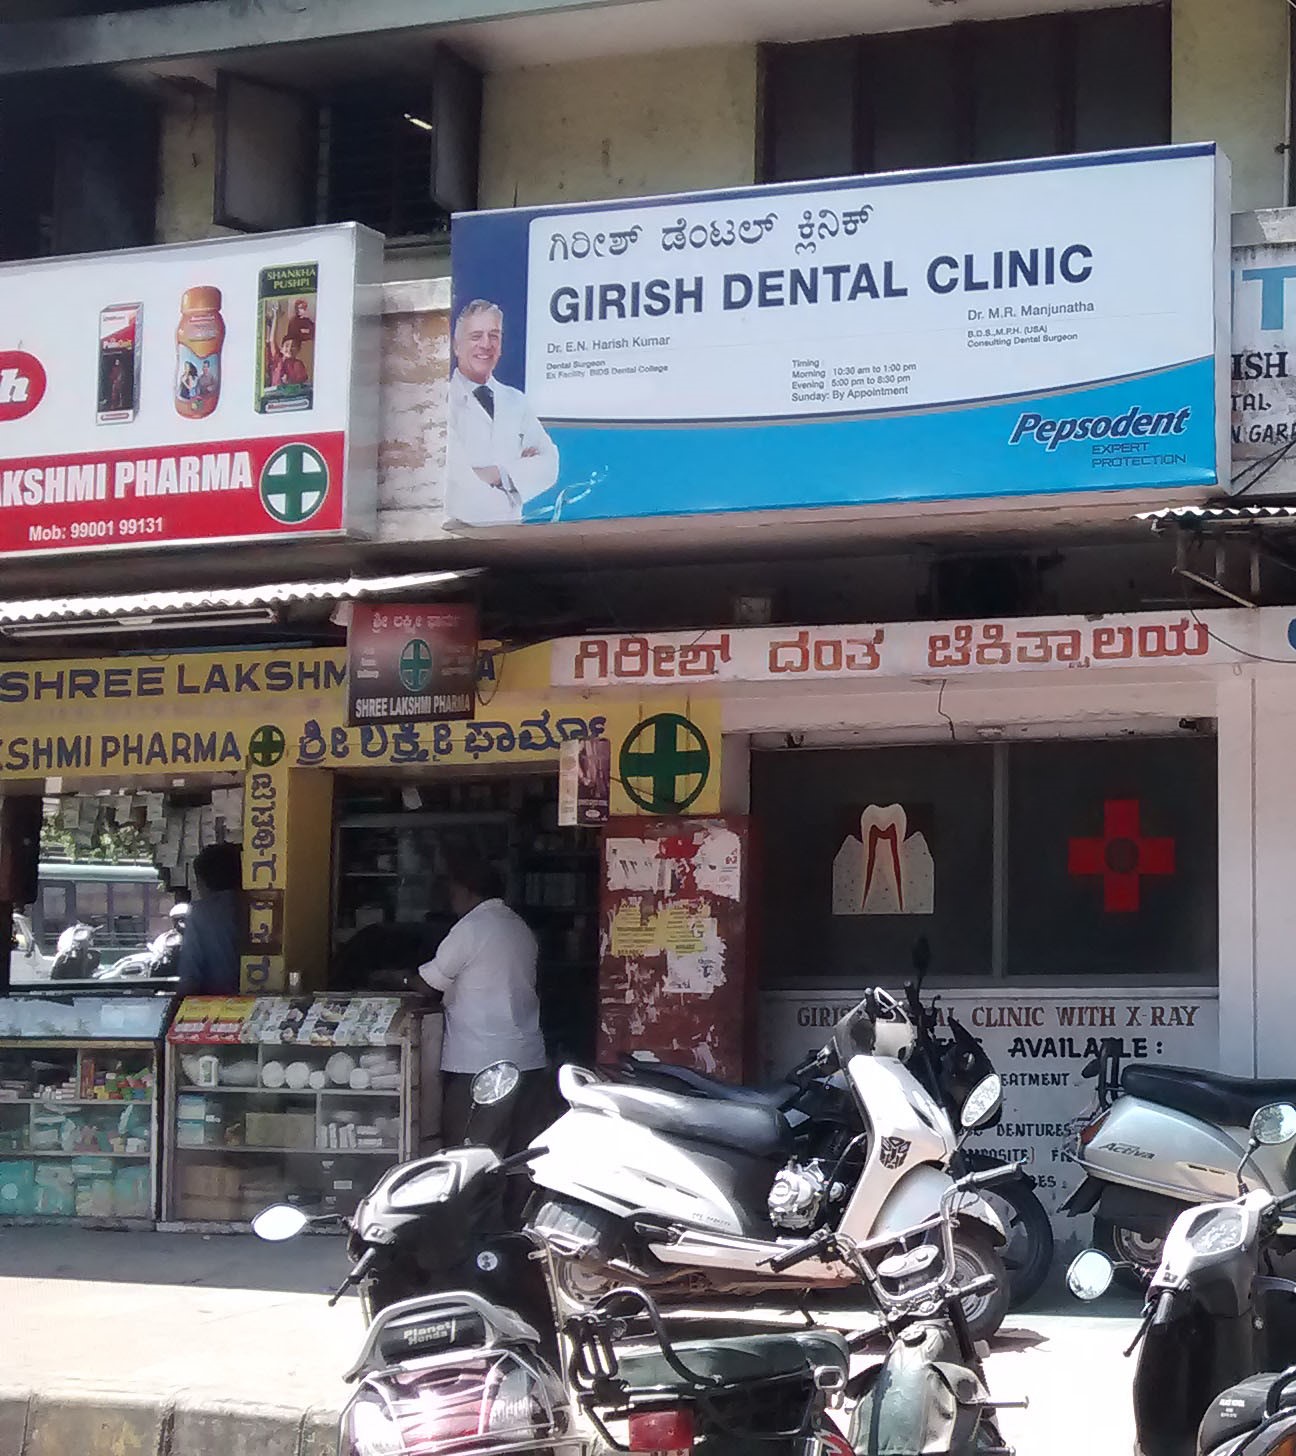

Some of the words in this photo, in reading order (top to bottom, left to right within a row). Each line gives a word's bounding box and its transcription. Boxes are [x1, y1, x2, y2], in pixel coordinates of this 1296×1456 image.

[549, 224, 643, 261] ಗಿರೀಶ್
[661, 212, 778, 251] ಡೆಂಟಲ್
[794, 203, 874, 255] ಕ್ಲಿನಿಕ್
[267, 268, 317, 281] SHANKHA
[273, 278, 310, 290] PUSHPI
[550, 276, 704, 324] GIRISH
[723, 261, 908, 311] DENTAL
[927, 244, 1093, 294] CLINIC
[968, 310, 984, 321] Dr.
[989, 306, 1016, 318] M.R.
[1021, 301, 1095, 317] Manjunatha
[547, 343, 562, 354] Dr.
[592, 338, 629, 351] Harish
[632, 336, 671, 348] Kumar
[967, 338, 1012, 348] Consulting
[1013, 335, 1041, 345] Dental
[1043, 333, 1078, 343] Surgeon
[792, 370, 826, 379] Morning
[792, 381, 825, 390] Evening
[832, 390, 846, 401] By
[847, 386, 909, 399] Appointment
[1008, 406, 1191, 452] Pepsodent
[1092, 442, 1150, 455] EXPERT
[1092, 454, 1187, 468] PROTECTION
[0, 462, 107, 507] KSHMI
[114, 451, 253, 497] PHARMA
[29, 524, 66, 542] Mob:
[71, 520, 114, 539] 99001
[119, 517, 164, 536] 99131
[573, 633, 732, 680] ಗಿರೀಶ್
[768, 628, 886, 674] ದಂತ
[0, 666, 165, 702] SHREE
[176, 660, 347, 694] LAKSHM
[355, 697, 388, 718] SHREE
[389, 696, 432, 716] LAKSHMI
[433, 694, 471, 713] PHARMA
[0, 735, 92, 771] SHMI
[100, 731, 242, 768] PHARMA
[973, 1006, 1044, 1028] CLINIC
[1056, 1005, 1117, 1028] WITH
[1001, 1073, 1071, 1087] EATMENT
[996, 1123, 1072, 1137] DENTURES
[1099, 1142, 1155, 1160] Activa
[403, 1321, 452, 1340] Planet
[408, 1330, 448, 1346] Honda
